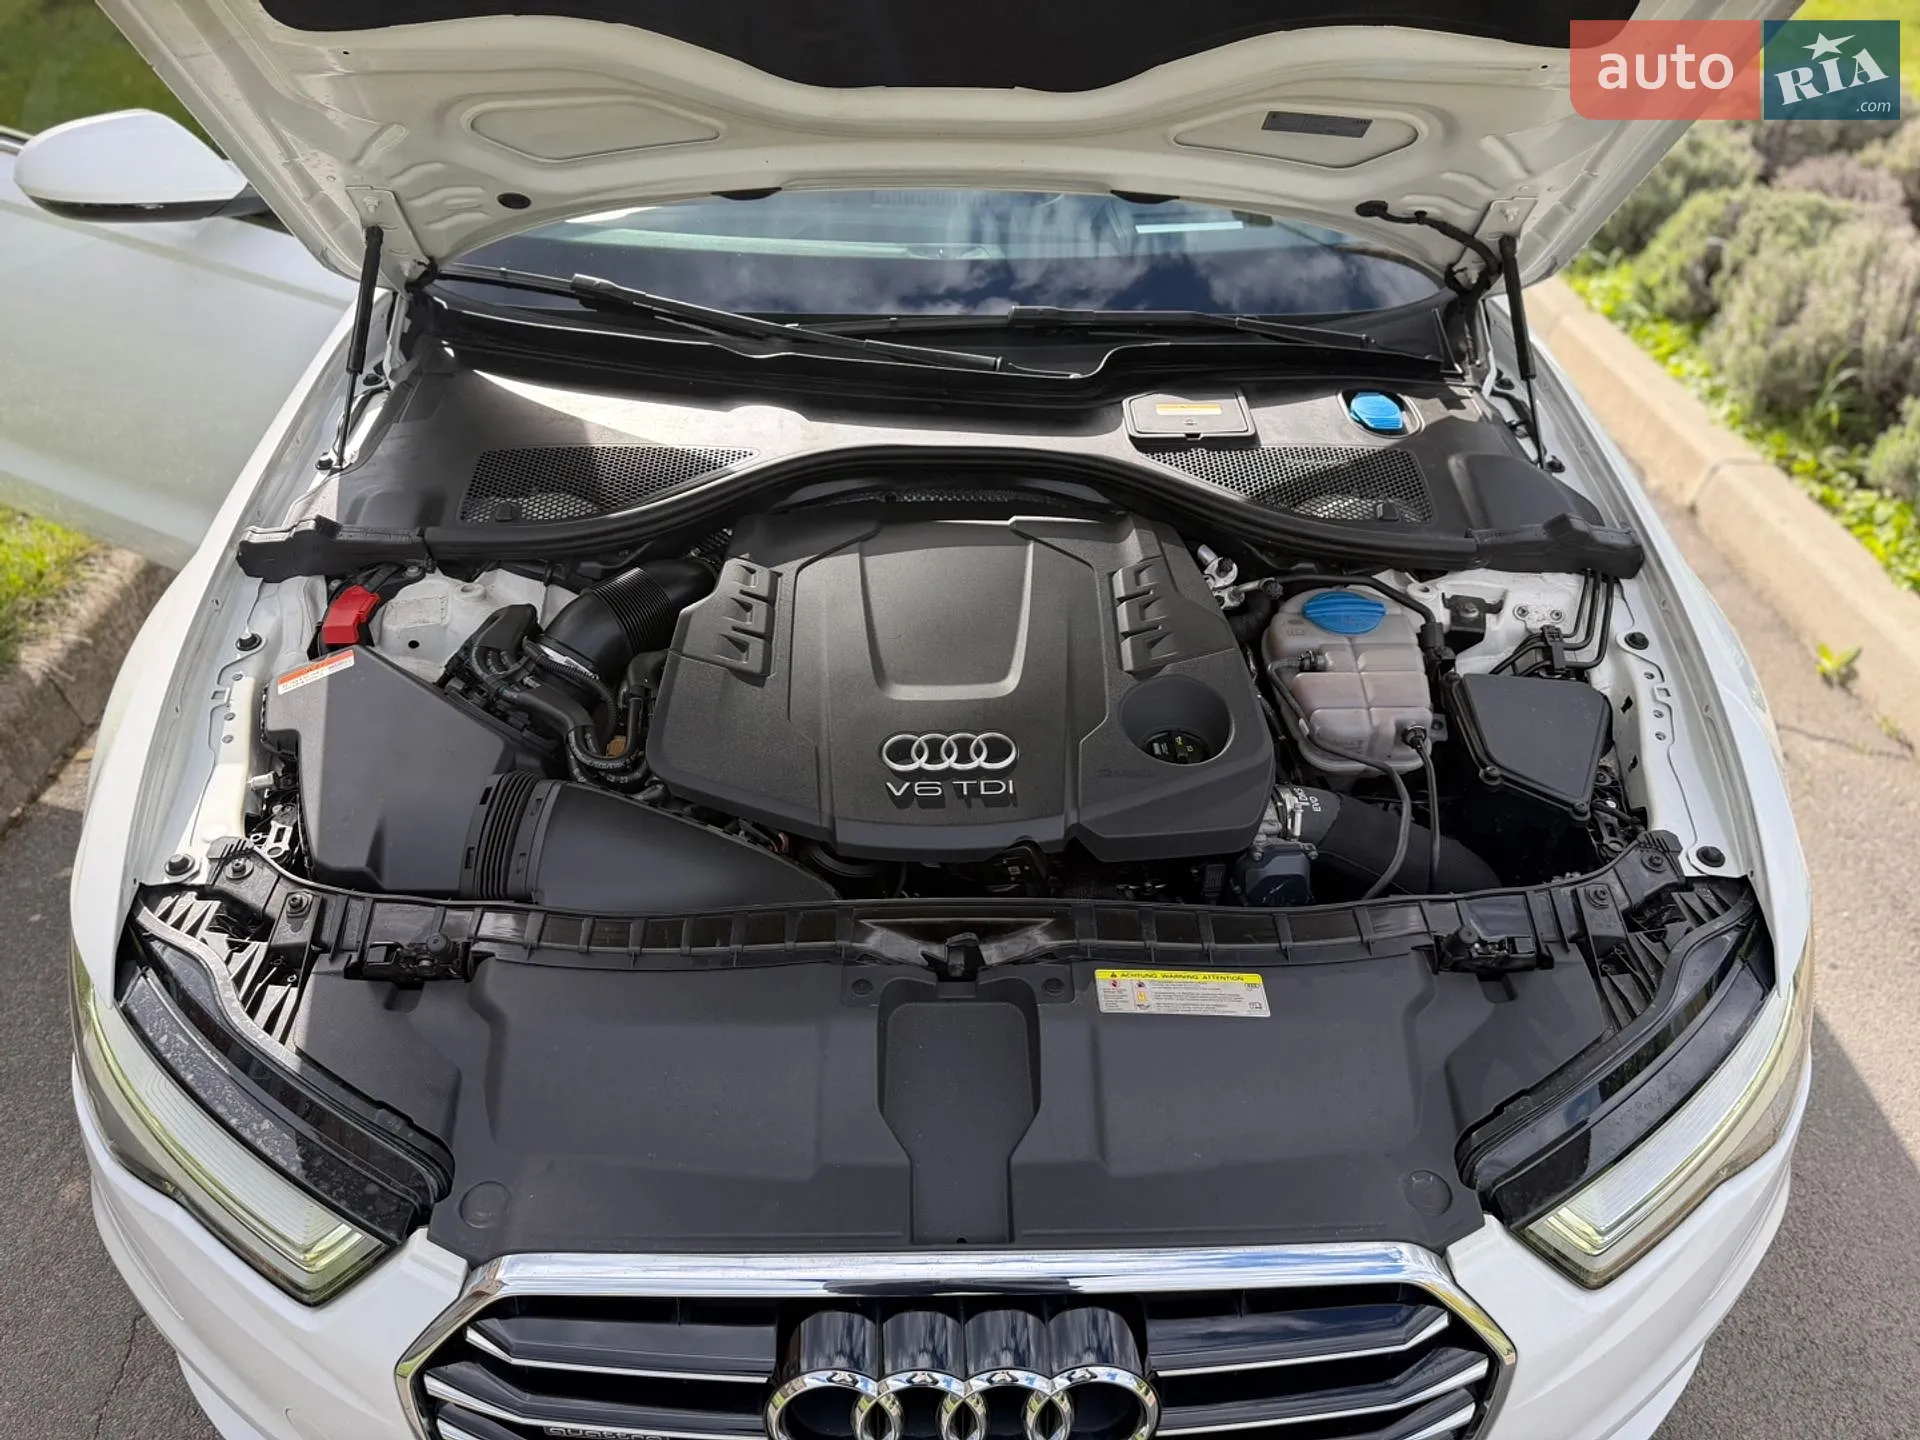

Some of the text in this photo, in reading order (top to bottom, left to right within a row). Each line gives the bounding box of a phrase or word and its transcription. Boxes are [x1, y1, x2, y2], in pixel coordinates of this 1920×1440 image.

[886, 780, 1014, 796] V6 TDI
[1120, 972, 1158, 980] ACHTUNG
[1161, 973, 1199, 981] WARNING
